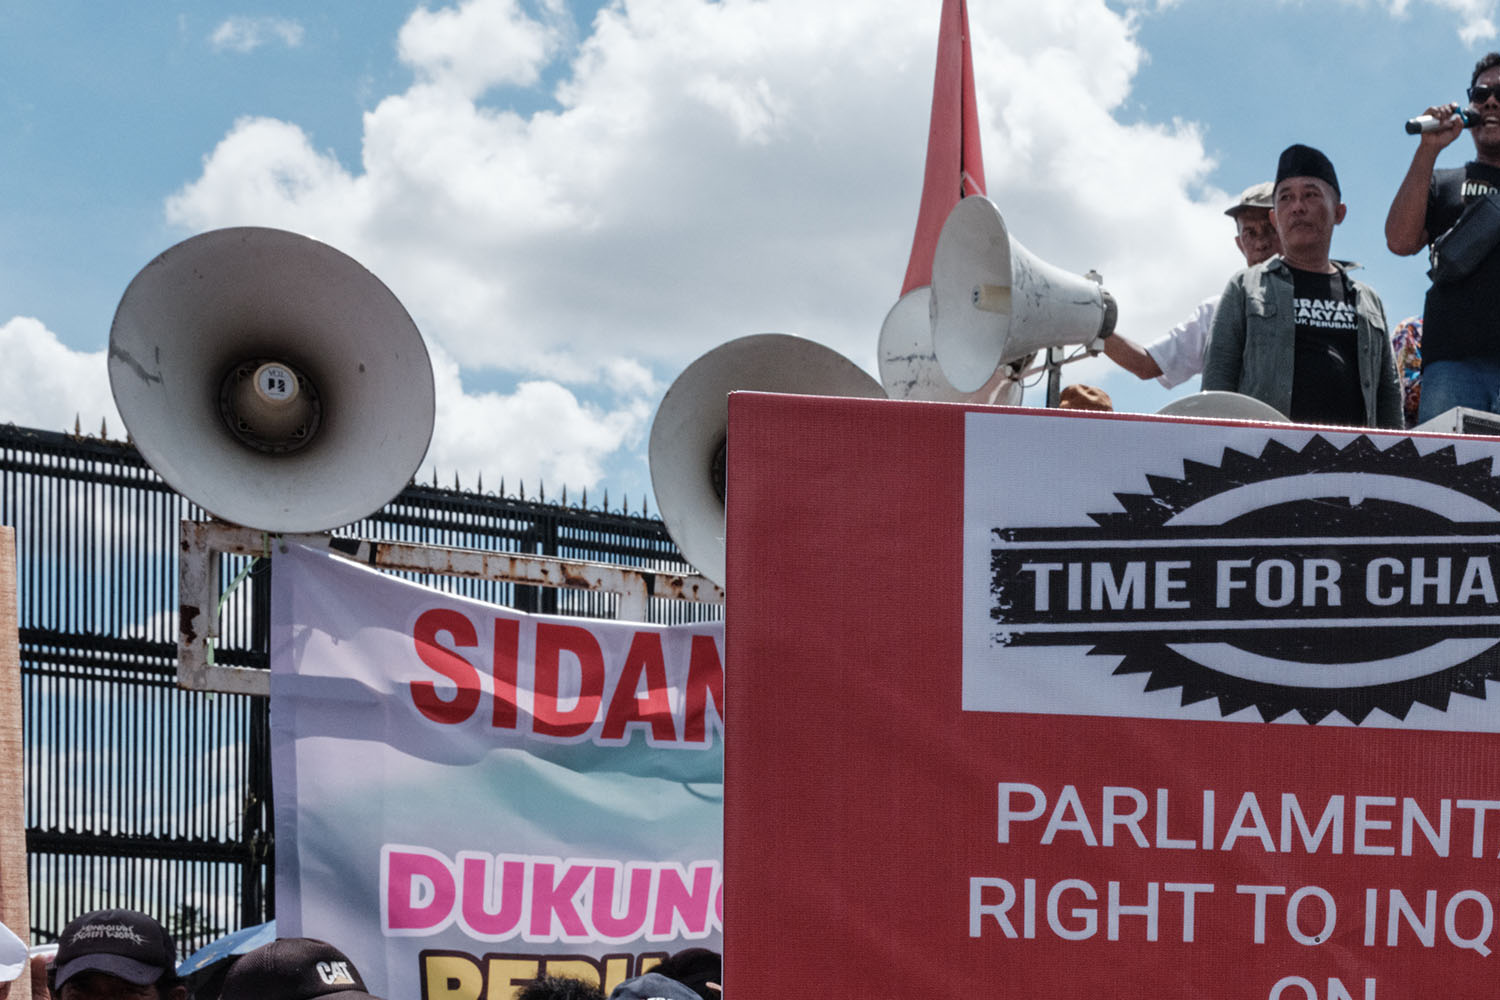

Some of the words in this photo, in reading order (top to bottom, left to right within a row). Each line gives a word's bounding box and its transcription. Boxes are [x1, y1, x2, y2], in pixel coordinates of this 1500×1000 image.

[1293, 298, 1356, 313] ERAKAN
[1294, 308, 1355, 323] AKYAT
[1310, 319, 1359, 330] PERUBAH
[1022, 560, 1191, 612] TIME
[1216, 557, 1341, 610] FOR
[410, 608, 724, 743] SIDAN
[388, 852, 724, 937] DUKUN
[968, 877, 1214, 943] RIGHT
[1236, 884, 1337, 945] TO
[316, 961, 352, 985] CAT
